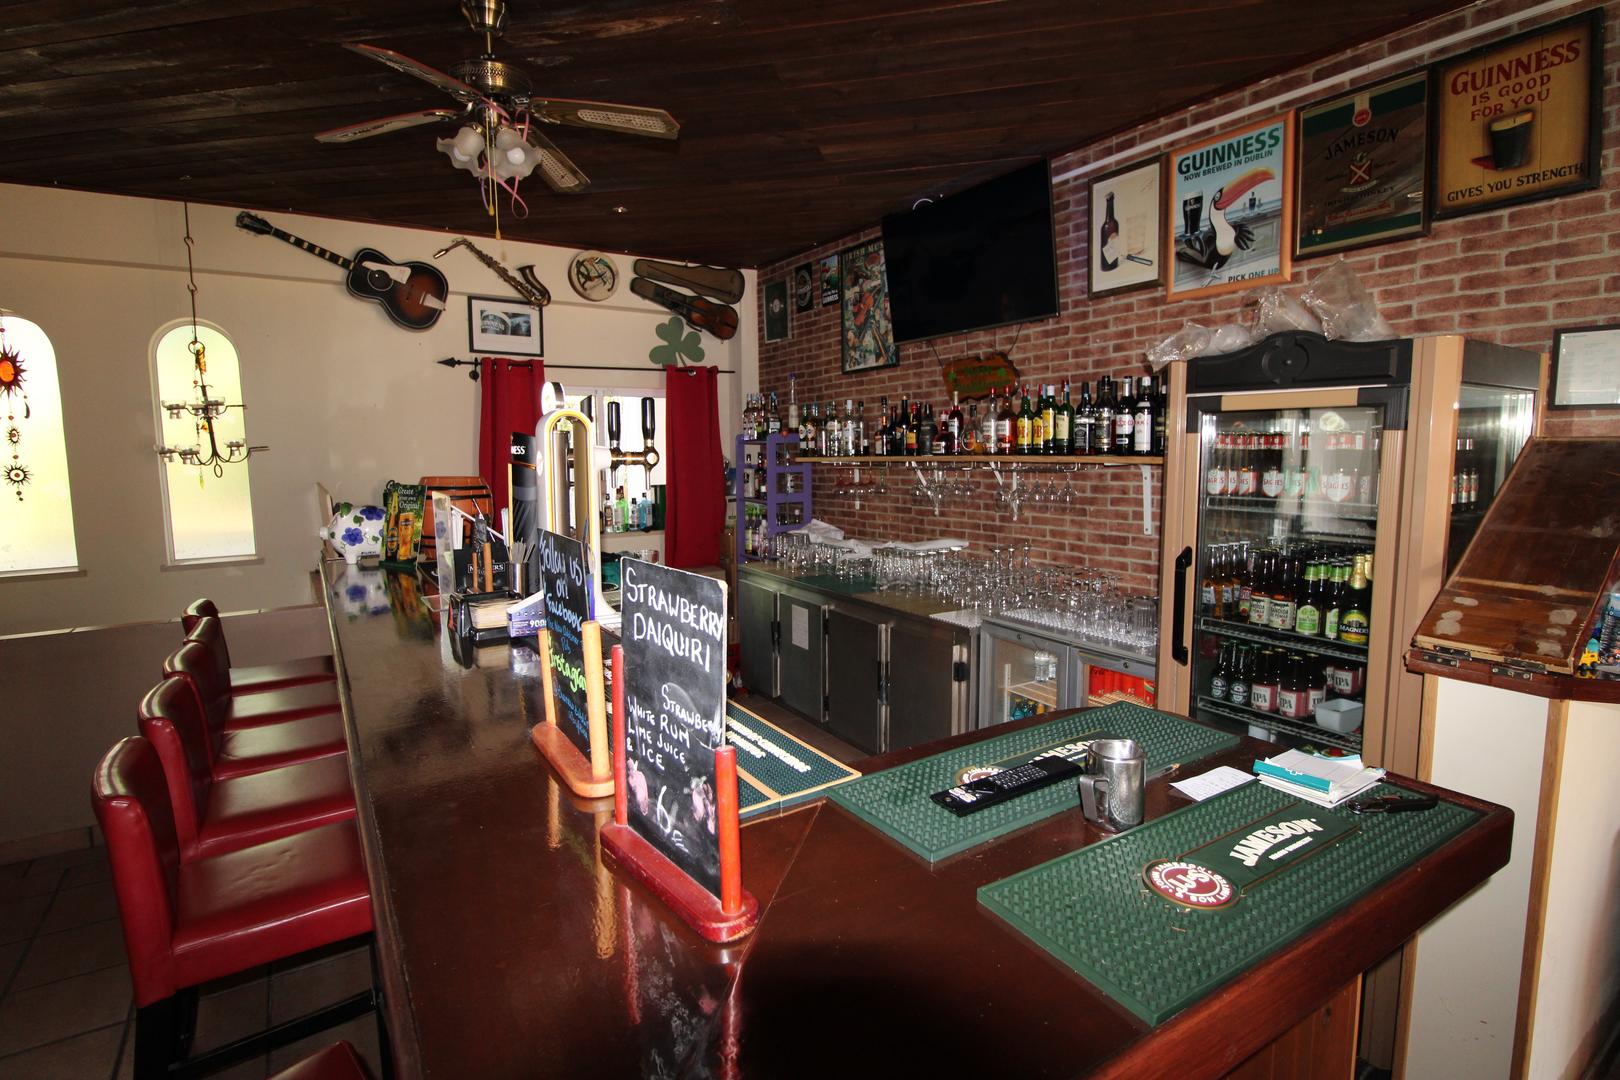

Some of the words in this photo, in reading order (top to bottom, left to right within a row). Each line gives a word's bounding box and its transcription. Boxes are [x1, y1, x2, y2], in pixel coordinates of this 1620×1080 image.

[1451, 38, 1581, 96] GUINNESS
[1470, 103, 1504, 121] FOR
[1511, 88, 1550, 109] YOU
[1471, 91, 1491, 106] IS
[1499, 73, 1551, 98] GOOD
[1177, 128, 1281, 176] GUINNESS
[1325, 128, 1400, 160] JAMESON
[1184, 171, 1201, 182] NOW
[1202, 163, 1233, 177] BREWED
[1234, 159, 1243, 167] IN
[1244, 150, 1273, 164] DUBLIN
[1447, 185, 1484, 202] GIVES
[1487, 178, 1512, 193] YOU
[1516, 162, 1585, 187] STRENGTH
[1228, 274, 1246, 283] PICK
[1248, 271, 1265, 280] ONE
[1267, 268, 1280, 277] UP
[398, 487, 414, 495] Create
[399, 501, 420, 511] Original
[626, 567, 723, 641] STRAWBERRY
[634, 612, 710, 673] DAIQUIRI
[548, 649, 588, 694] Instagra
[1253, 691, 1268, 703] IPA
[628, 695, 655, 726] WHITE
[660, 714, 690, 748] RUM
[628, 717, 652, 744] LIME
[657, 736, 686, 764] JUICE
[642, 744, 665, 770] ICE
[1230, 818, 1324, 867] JAMESON
